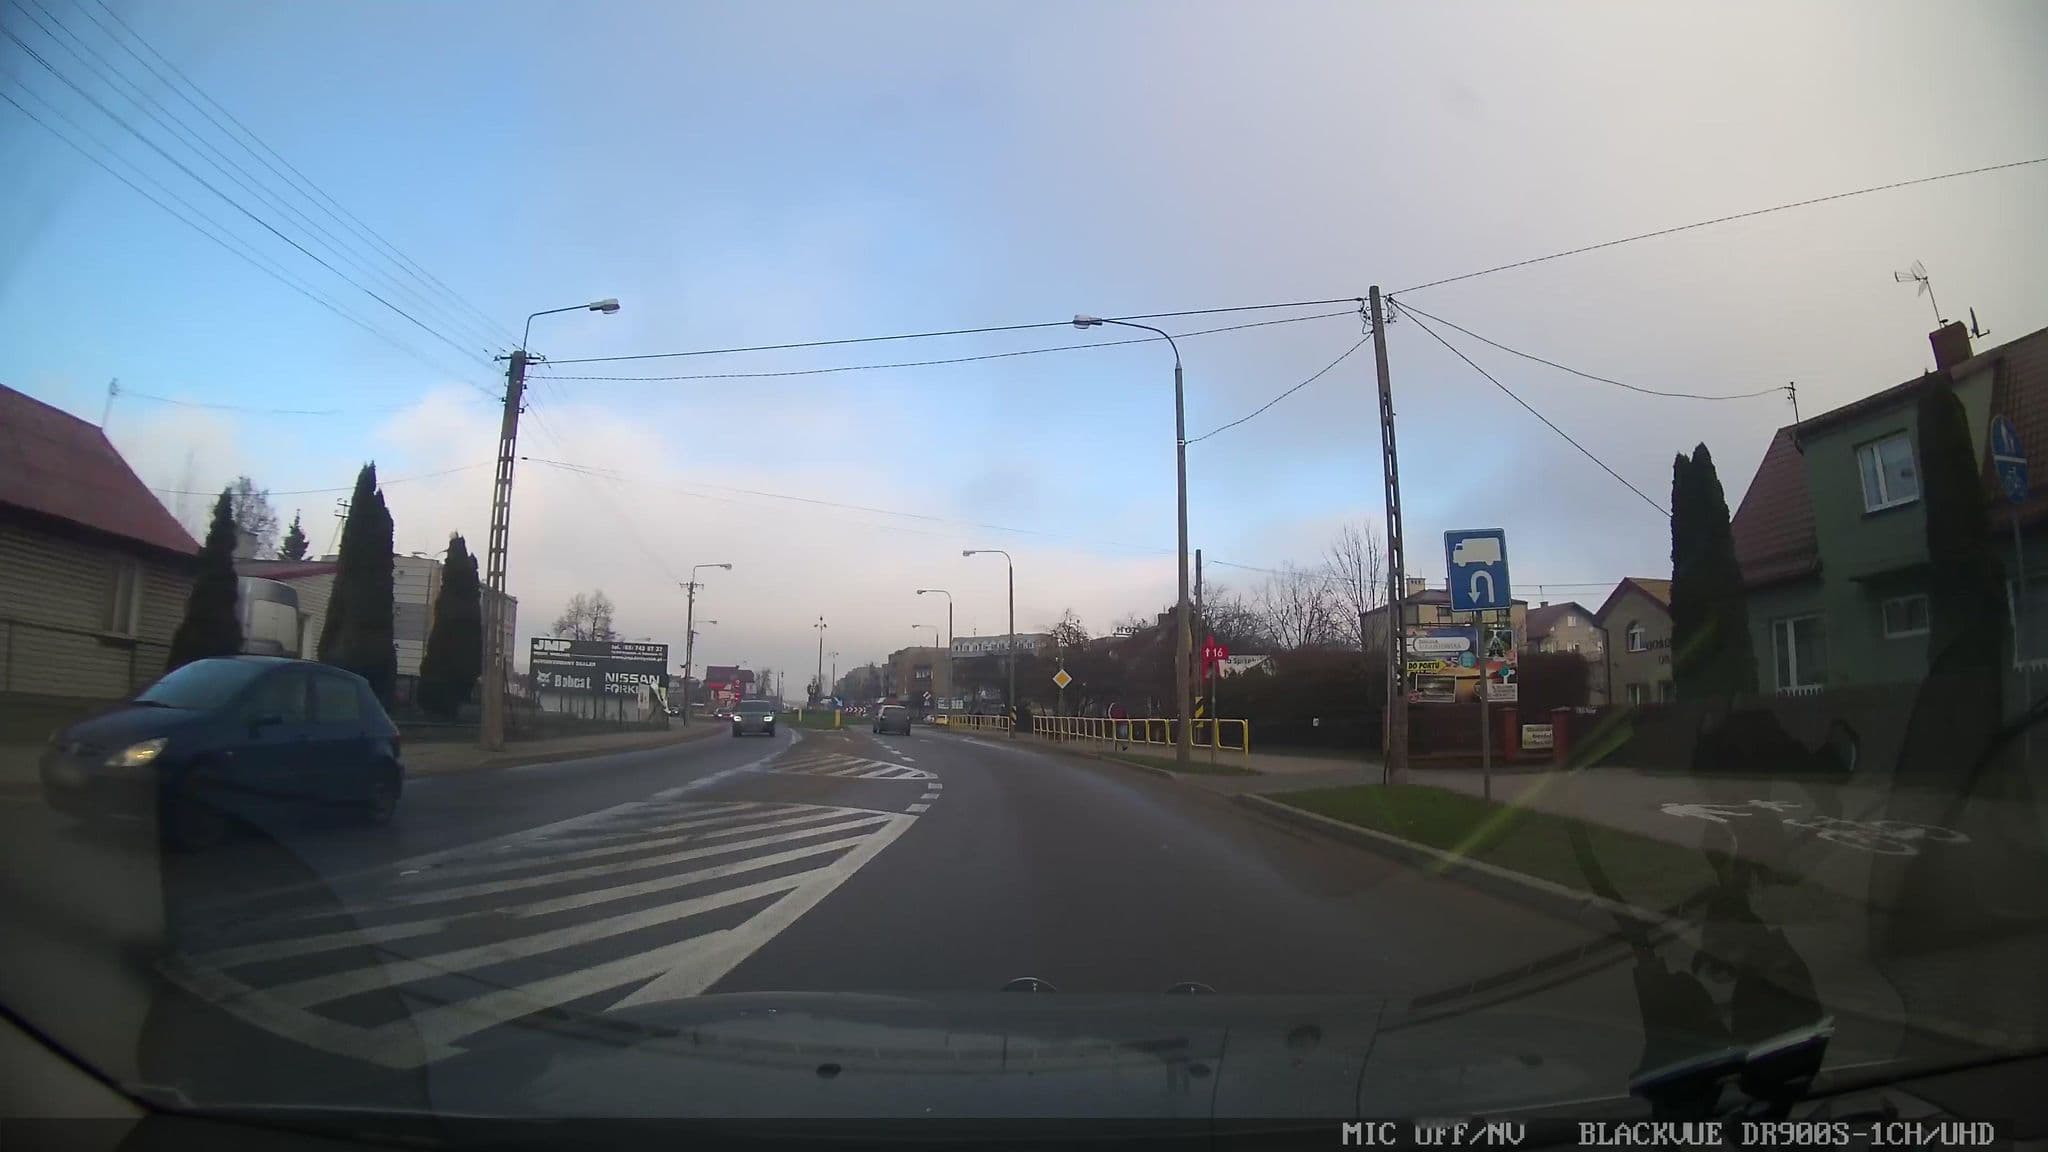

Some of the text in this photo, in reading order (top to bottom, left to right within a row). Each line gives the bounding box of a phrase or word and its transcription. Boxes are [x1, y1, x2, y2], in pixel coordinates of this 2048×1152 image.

[533, 639, 572, 651] JMP
[1213, 648, 1223, 657] 16
[554, 674, 592, 689] Bobcat
[605, 672, 660, 684] NISSAN
